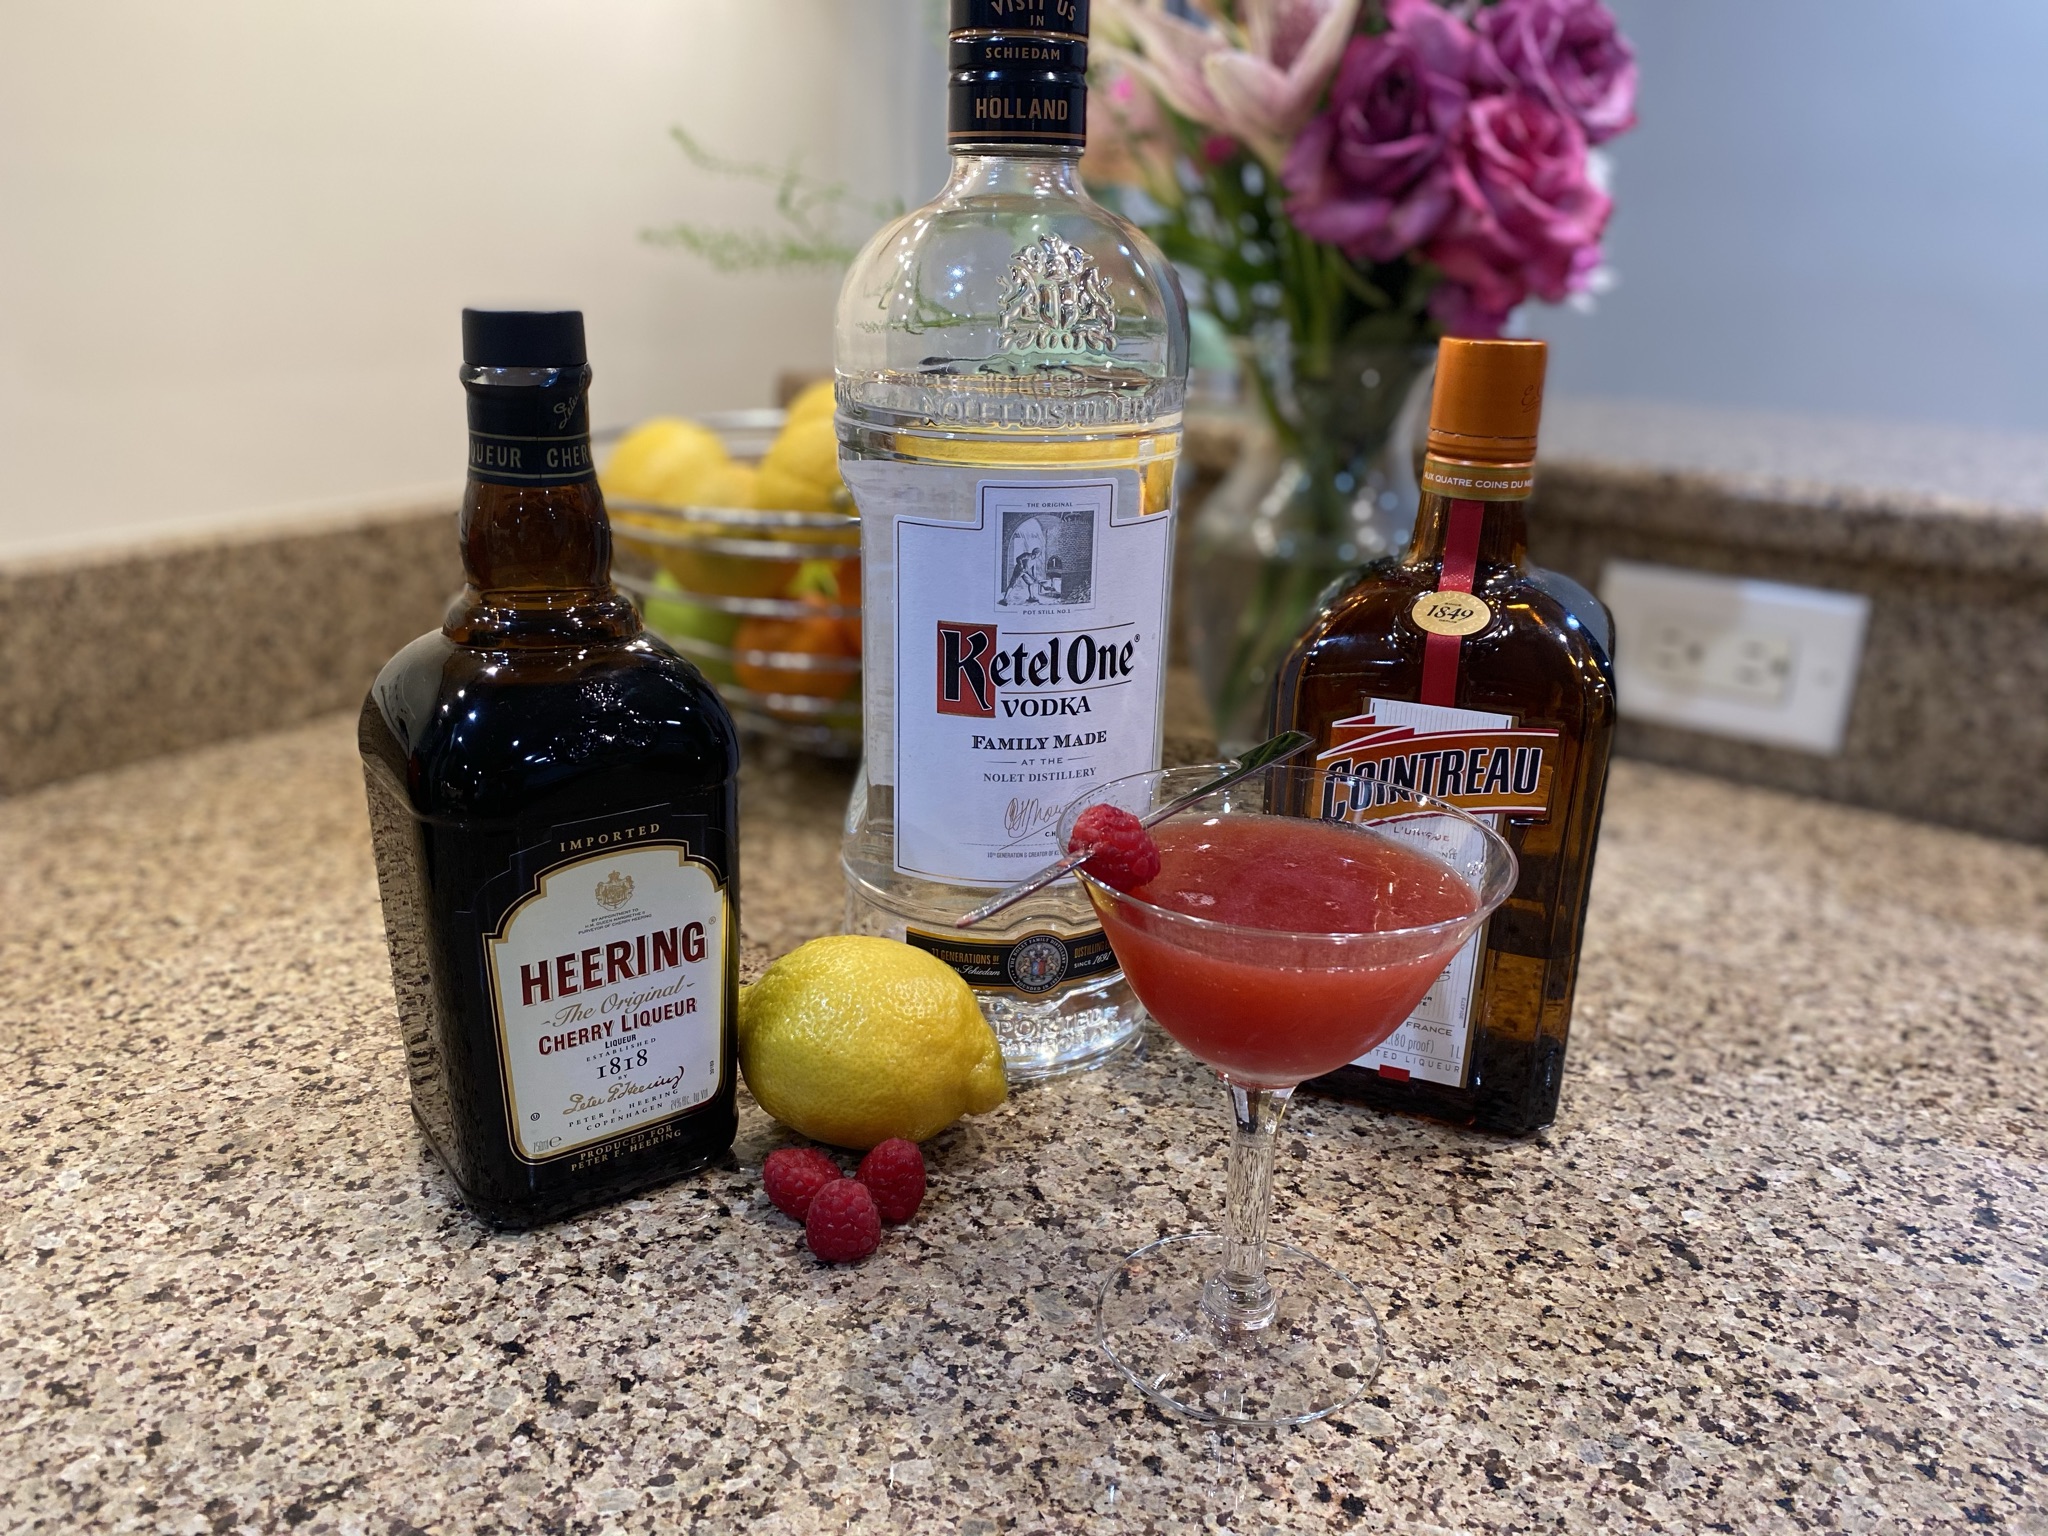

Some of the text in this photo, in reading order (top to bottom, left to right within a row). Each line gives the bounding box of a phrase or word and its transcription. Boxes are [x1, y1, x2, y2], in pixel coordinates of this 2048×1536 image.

[991, 0, 1077, 21] VISIT US
[1030, 15, 1044, 26] IN
[985, 47, 1060, 60] SCHIEDAM
[976, 97, 1068, 120] HOLLAND
[547, 443, 592, 468] CHER
[1435, 475, 1473, 487] QUATRE
[1475, 480, 1509, 489] COINS
[1510, 480, 1523, 489] DU
[1426, 604, 1474, 621] 1849
[940, 629, 1134, 711] Ketel One
[1001, 695, 1091, 718] VODKA
[971, 730, 1107, 751] FAMILY MADE
[1021, 757, 1063, 766] AT THE
[983, 767, 1097, 783] NOLET DISTILLERY
[1321, 747, 1543, 822] COINTREAU
[560, 823, 660, 852] IMPORTED
[520, 921, 708, 1007] HEERING
[940, 950, 991, 965] GENERATIONS
[1074, 960, 1091, 969] SINCE
[552, 975, 684, 1027] The Original
[539, 997, 697, 1056] CHERRY LIQUEUR
[1406, 1021, 1453, 1037] FRANCE
[586, 1037, 656, 1062] ESTABLISHED
[605, 1034, 637, 1049] LIQUEUR
[1407, 1039, 1435, 1054] proof)
[596, 1048, 648, 1080] 1818
[1405, 1056, 1460, 1073] LIQUEUR
[569, 1112, 604, 1128] PETER
[629, 1089, 678, 1109] HEERING
[586, 1102, 664, 1131] COPENHAGEN
[571, 1129, 682, 1172] PETER F. HEERING
[580, 1124, 673, 1161] PRODUCED FOR
